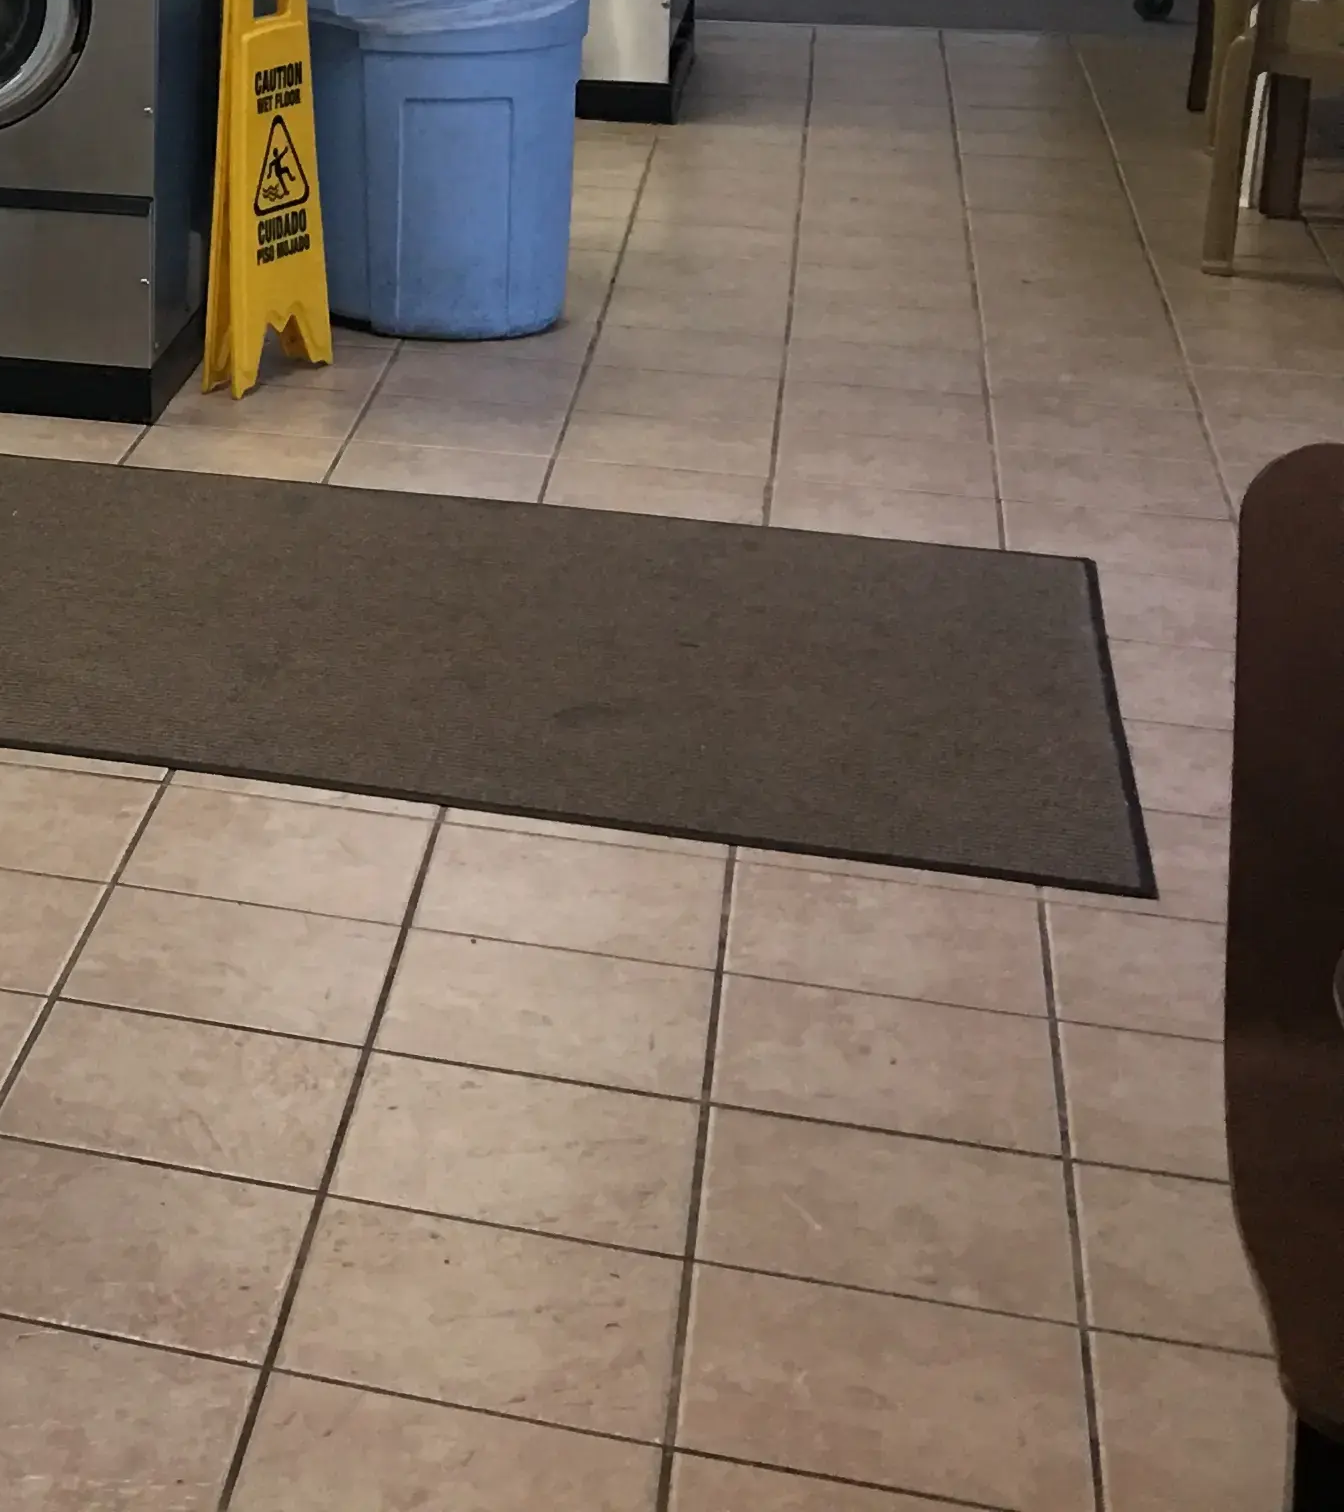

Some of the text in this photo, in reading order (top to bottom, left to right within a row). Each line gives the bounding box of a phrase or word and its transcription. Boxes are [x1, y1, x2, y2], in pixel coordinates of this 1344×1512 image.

[254, 61, 302, 96] CAUTION
[257, 93, 301, 114] WET FLOOR
[258, 208, 307, 245] CUIDADO
[257, 233, 310, 266] PISO MOJADO
